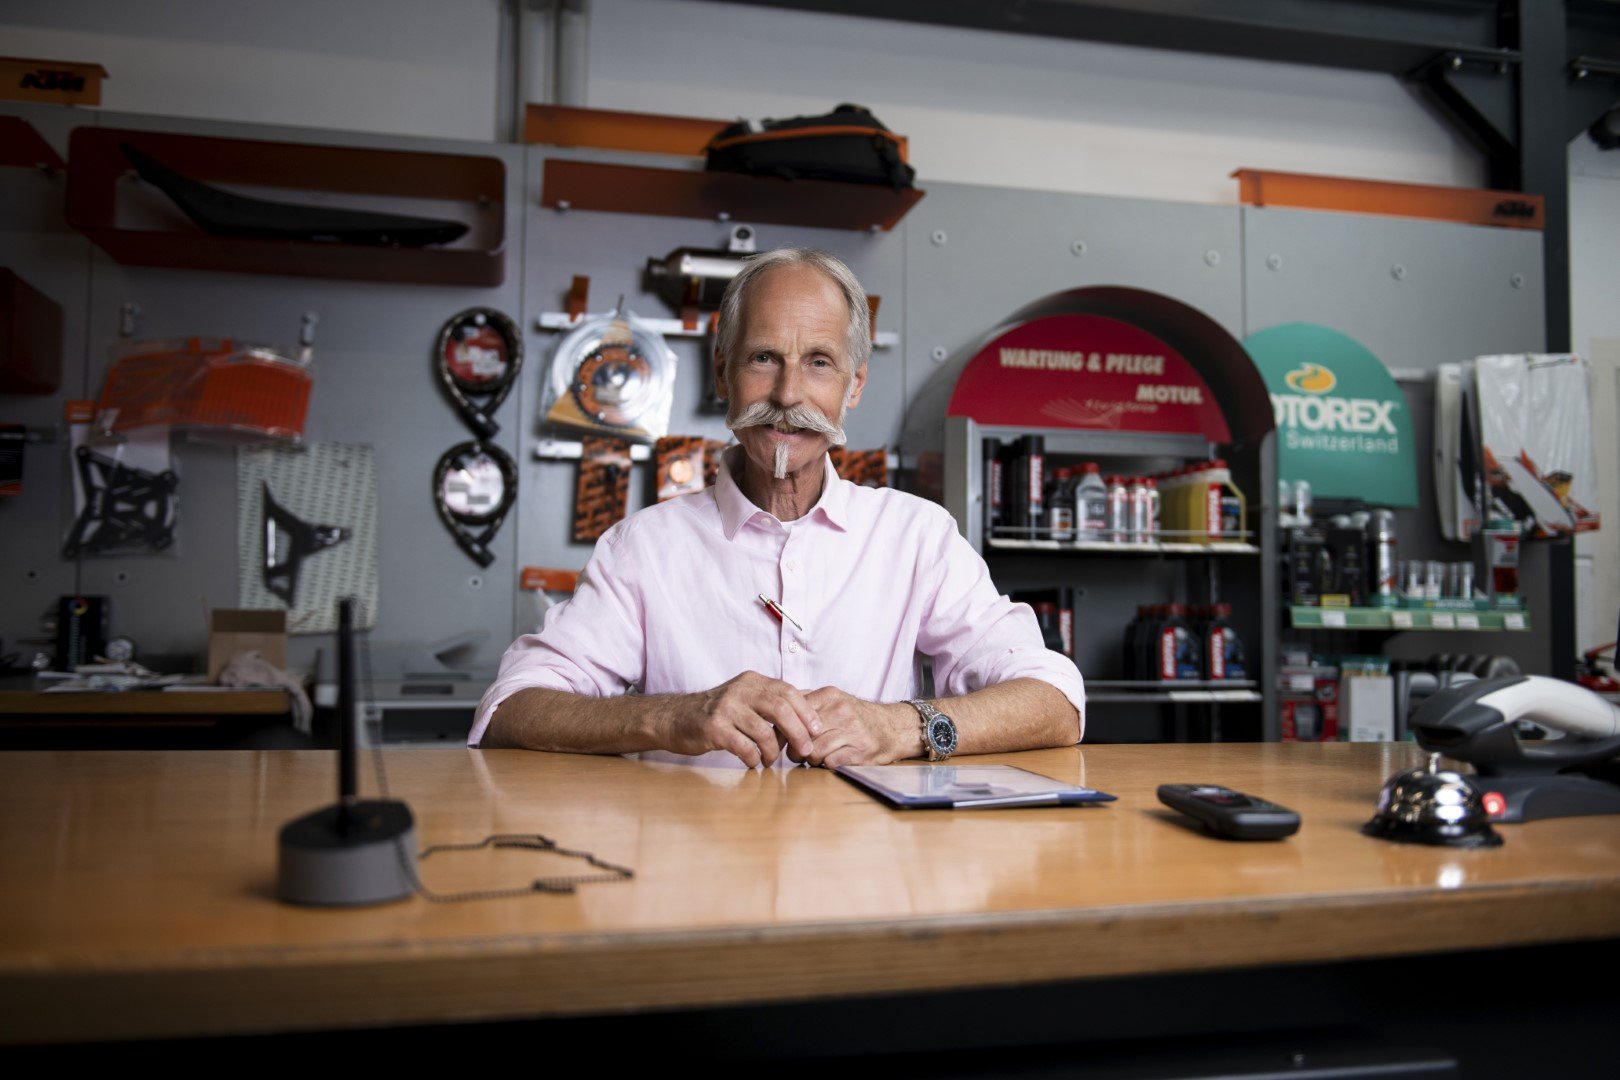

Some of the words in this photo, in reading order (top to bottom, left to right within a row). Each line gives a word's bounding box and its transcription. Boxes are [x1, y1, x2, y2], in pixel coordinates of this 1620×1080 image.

[999, 347, 1083, 371] WARTUNG
[1087, 351, 1101, 373] &
[1105, 352, 1166, 375] PFLEGE
[1136, 383, 1204, 405] MOTUL
[1286, 429, 1399, 455] Switzerland
